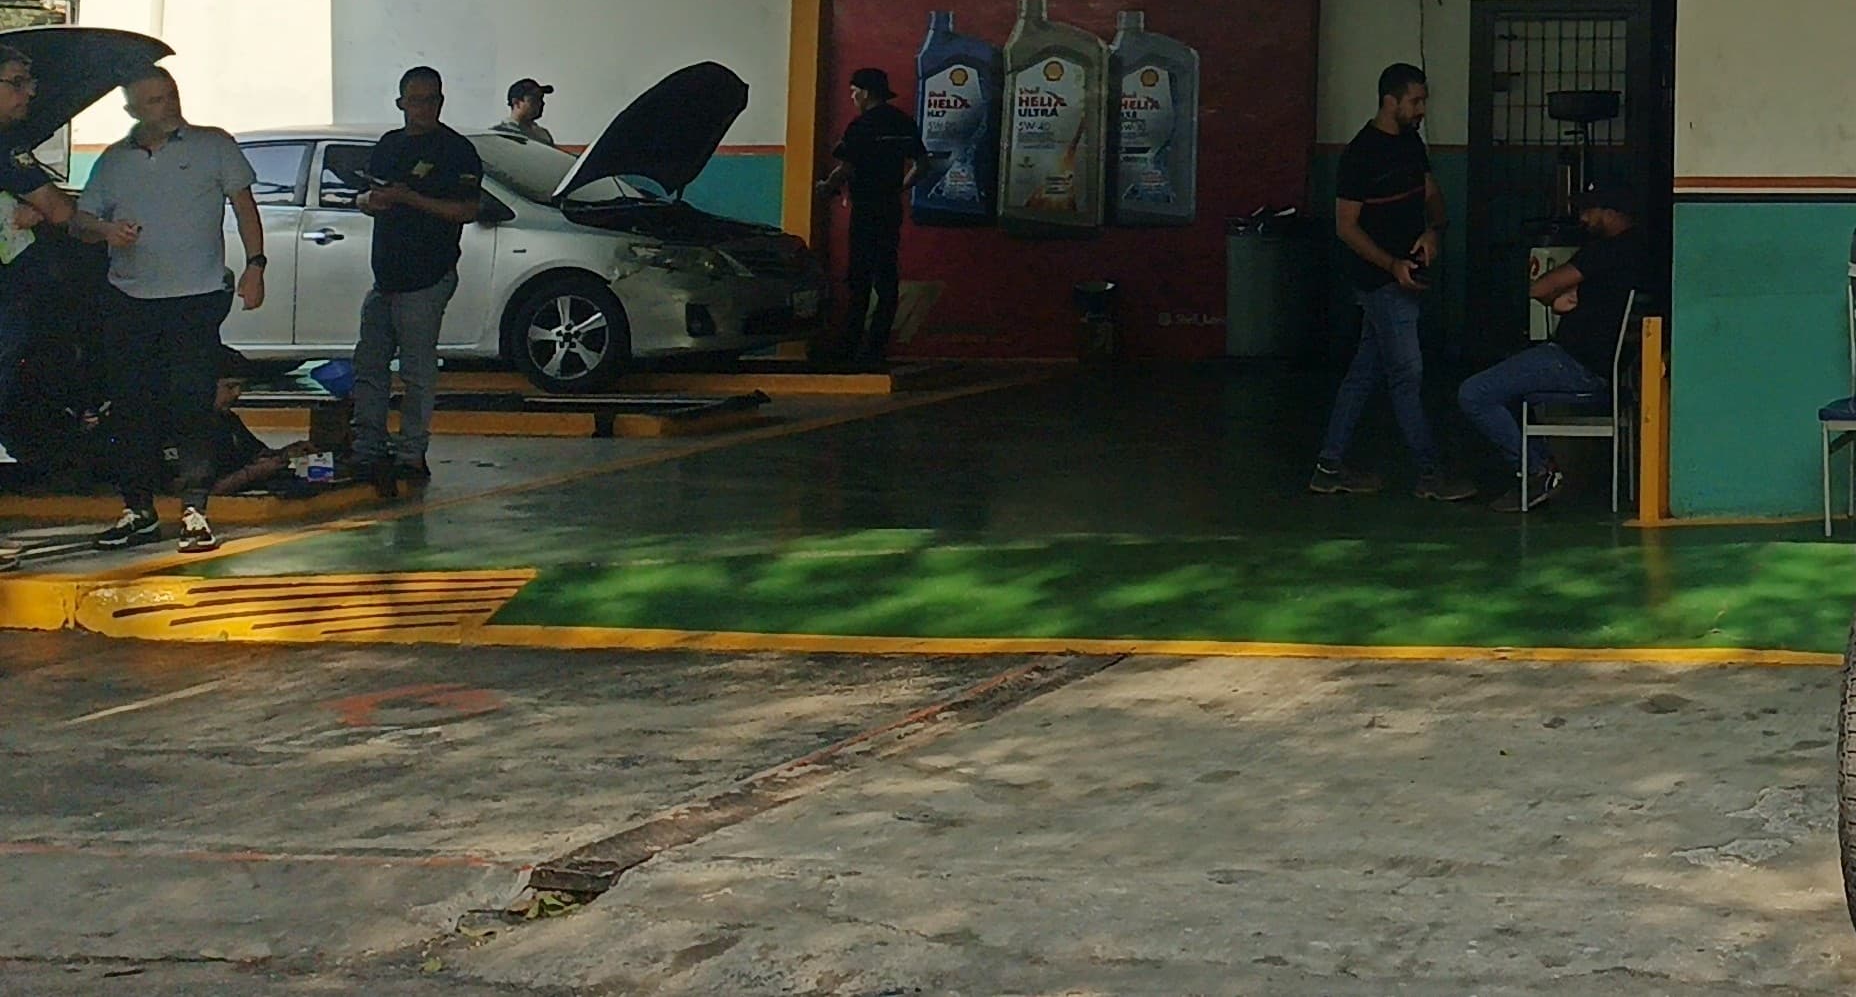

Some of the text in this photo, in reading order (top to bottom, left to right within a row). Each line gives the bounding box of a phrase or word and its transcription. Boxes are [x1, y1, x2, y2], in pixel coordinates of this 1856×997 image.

[927, 96, 972, 109] HELIX
[1018, 95, 1068, 107] HELIX
[1120, 97, 1161, 110] HELIX
[1018, 107, 1059, 118] ULTRA
